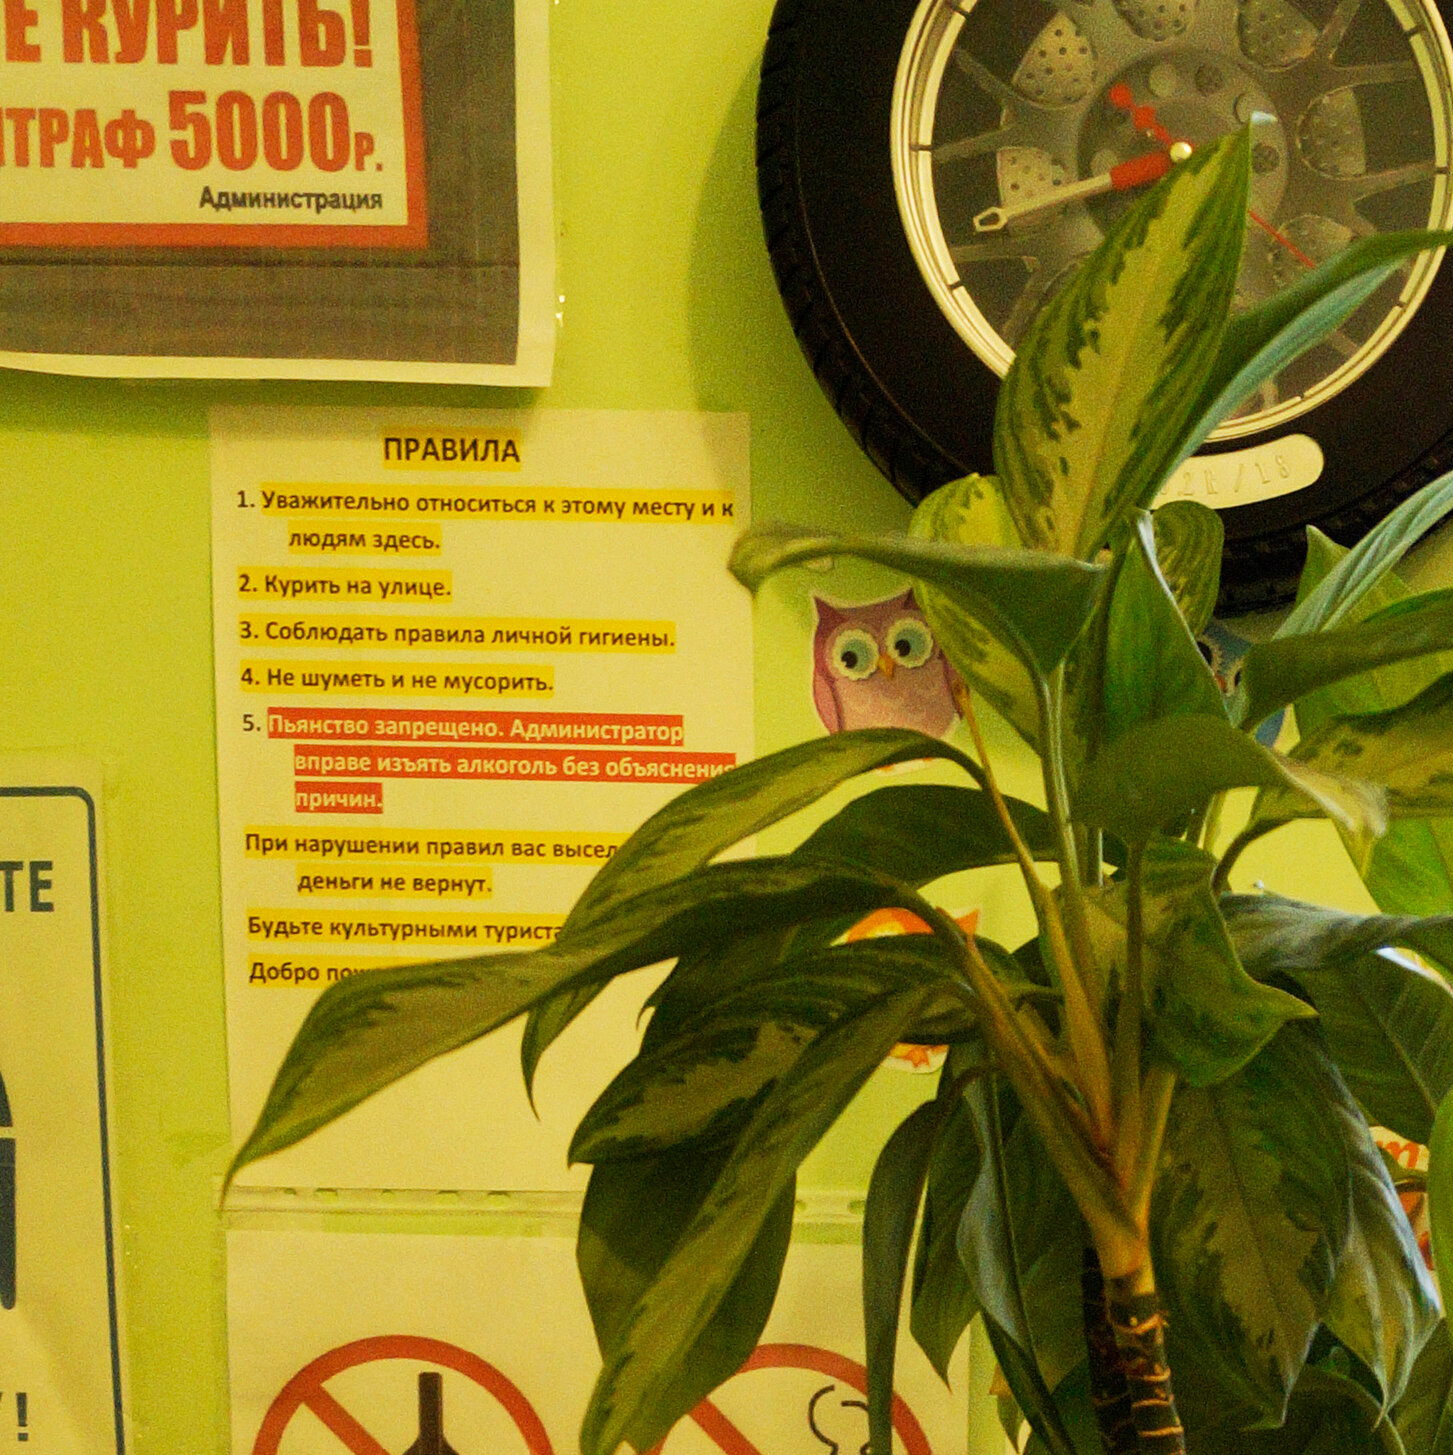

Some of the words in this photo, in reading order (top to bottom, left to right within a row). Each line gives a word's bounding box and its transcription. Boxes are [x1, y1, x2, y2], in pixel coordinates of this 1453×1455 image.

[62, 0, 373, 67] КУРИТЬ!
[0, 107, 156, 169] ТРАФ
[200, 185, 383, 213] Администрация
[384, 437, 520, 463] ПРАВИЛА
[237, 491, 255, 508] 1.
[262, 491, 409, 511] Уважительно
[416, 498, 536, 513] относиться
[544, 500, 555, 513] к
[562, 500, 626, 519] этому
[633, 502, 695, 520] месту
[702, 503, 714, 516] и
[722, 503, 734, 516] к
[289, 532, 366, 551] людям
[373, 533, 440, 552] здесь.
[238, 575, 257, 592] 2.
[265, 575, 340, 598] Курить
[347, 580, 372, 594] на
[379, 580, 451, 599] улице.
[240, 621, 258, 639] 3.
[266, 621, 387, 644] Соблюдать
[394, 628, 485, 645] правила
[491, 627, 572, 645] личной
[579, 631, 675, 647] гигиены.
[241, 668, 260, 685] 4.
[268, 669, 294, 686] Не
[302, 672, 385, 690] шуметь
[392, 674, 404, 688] и
[412, 675, 436, 688] не
[444, 676, 553, 694] мусорить.
[242, 714, 261, 731] 5.
[268, 715, 369, 735] Пьянство
[375, 719, 504, 739] запрещено.
[510, 719, 683, 744] Администратор
[295, 755, 371, 772] вправе
[378, 757, 451, 773] изъять
[457, 758, 558, 775] алкоголь
[563, 756, 600, 776] без
[295, 791, 383, 811] причин.
[246, 834, 288, 855] При
[295, 838, 419, 857] нарушении
[427, 841, 504, 859] правил
[512, 842, 546, 858] вас
[297, 875, 373, 893] деньги
[381, 877, 405, 891] не
[413, 878, 492, 896] вернут.
[249, 917, 323, 938] Будьте
[330, 920, 477, 940] культурными
[250, 963, 319, 984] Добро
